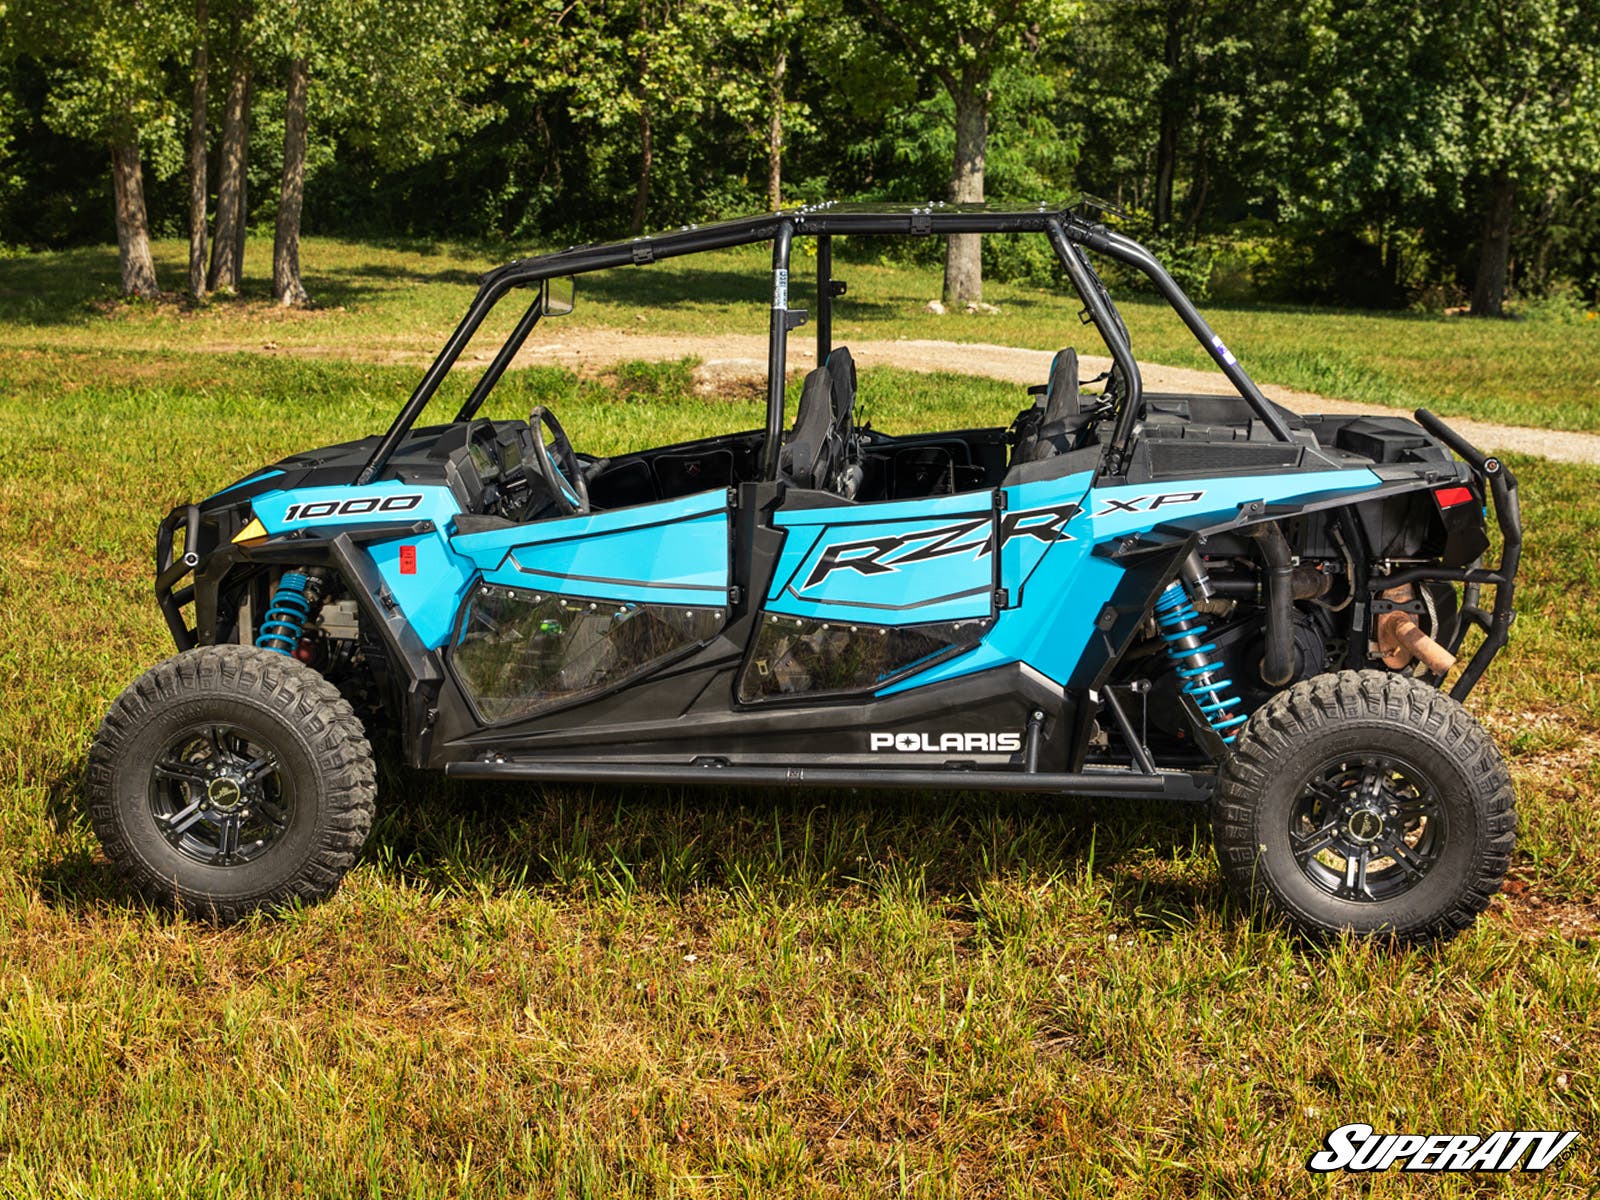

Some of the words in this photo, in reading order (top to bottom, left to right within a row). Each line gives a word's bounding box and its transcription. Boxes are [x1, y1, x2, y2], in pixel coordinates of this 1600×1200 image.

[284, 494, 423, 522] 1000
[800, 503, 1082, 592] RZR
[1092, 491, 1206, 517] XP
[870, 732, 1021, 752] POLARIS
